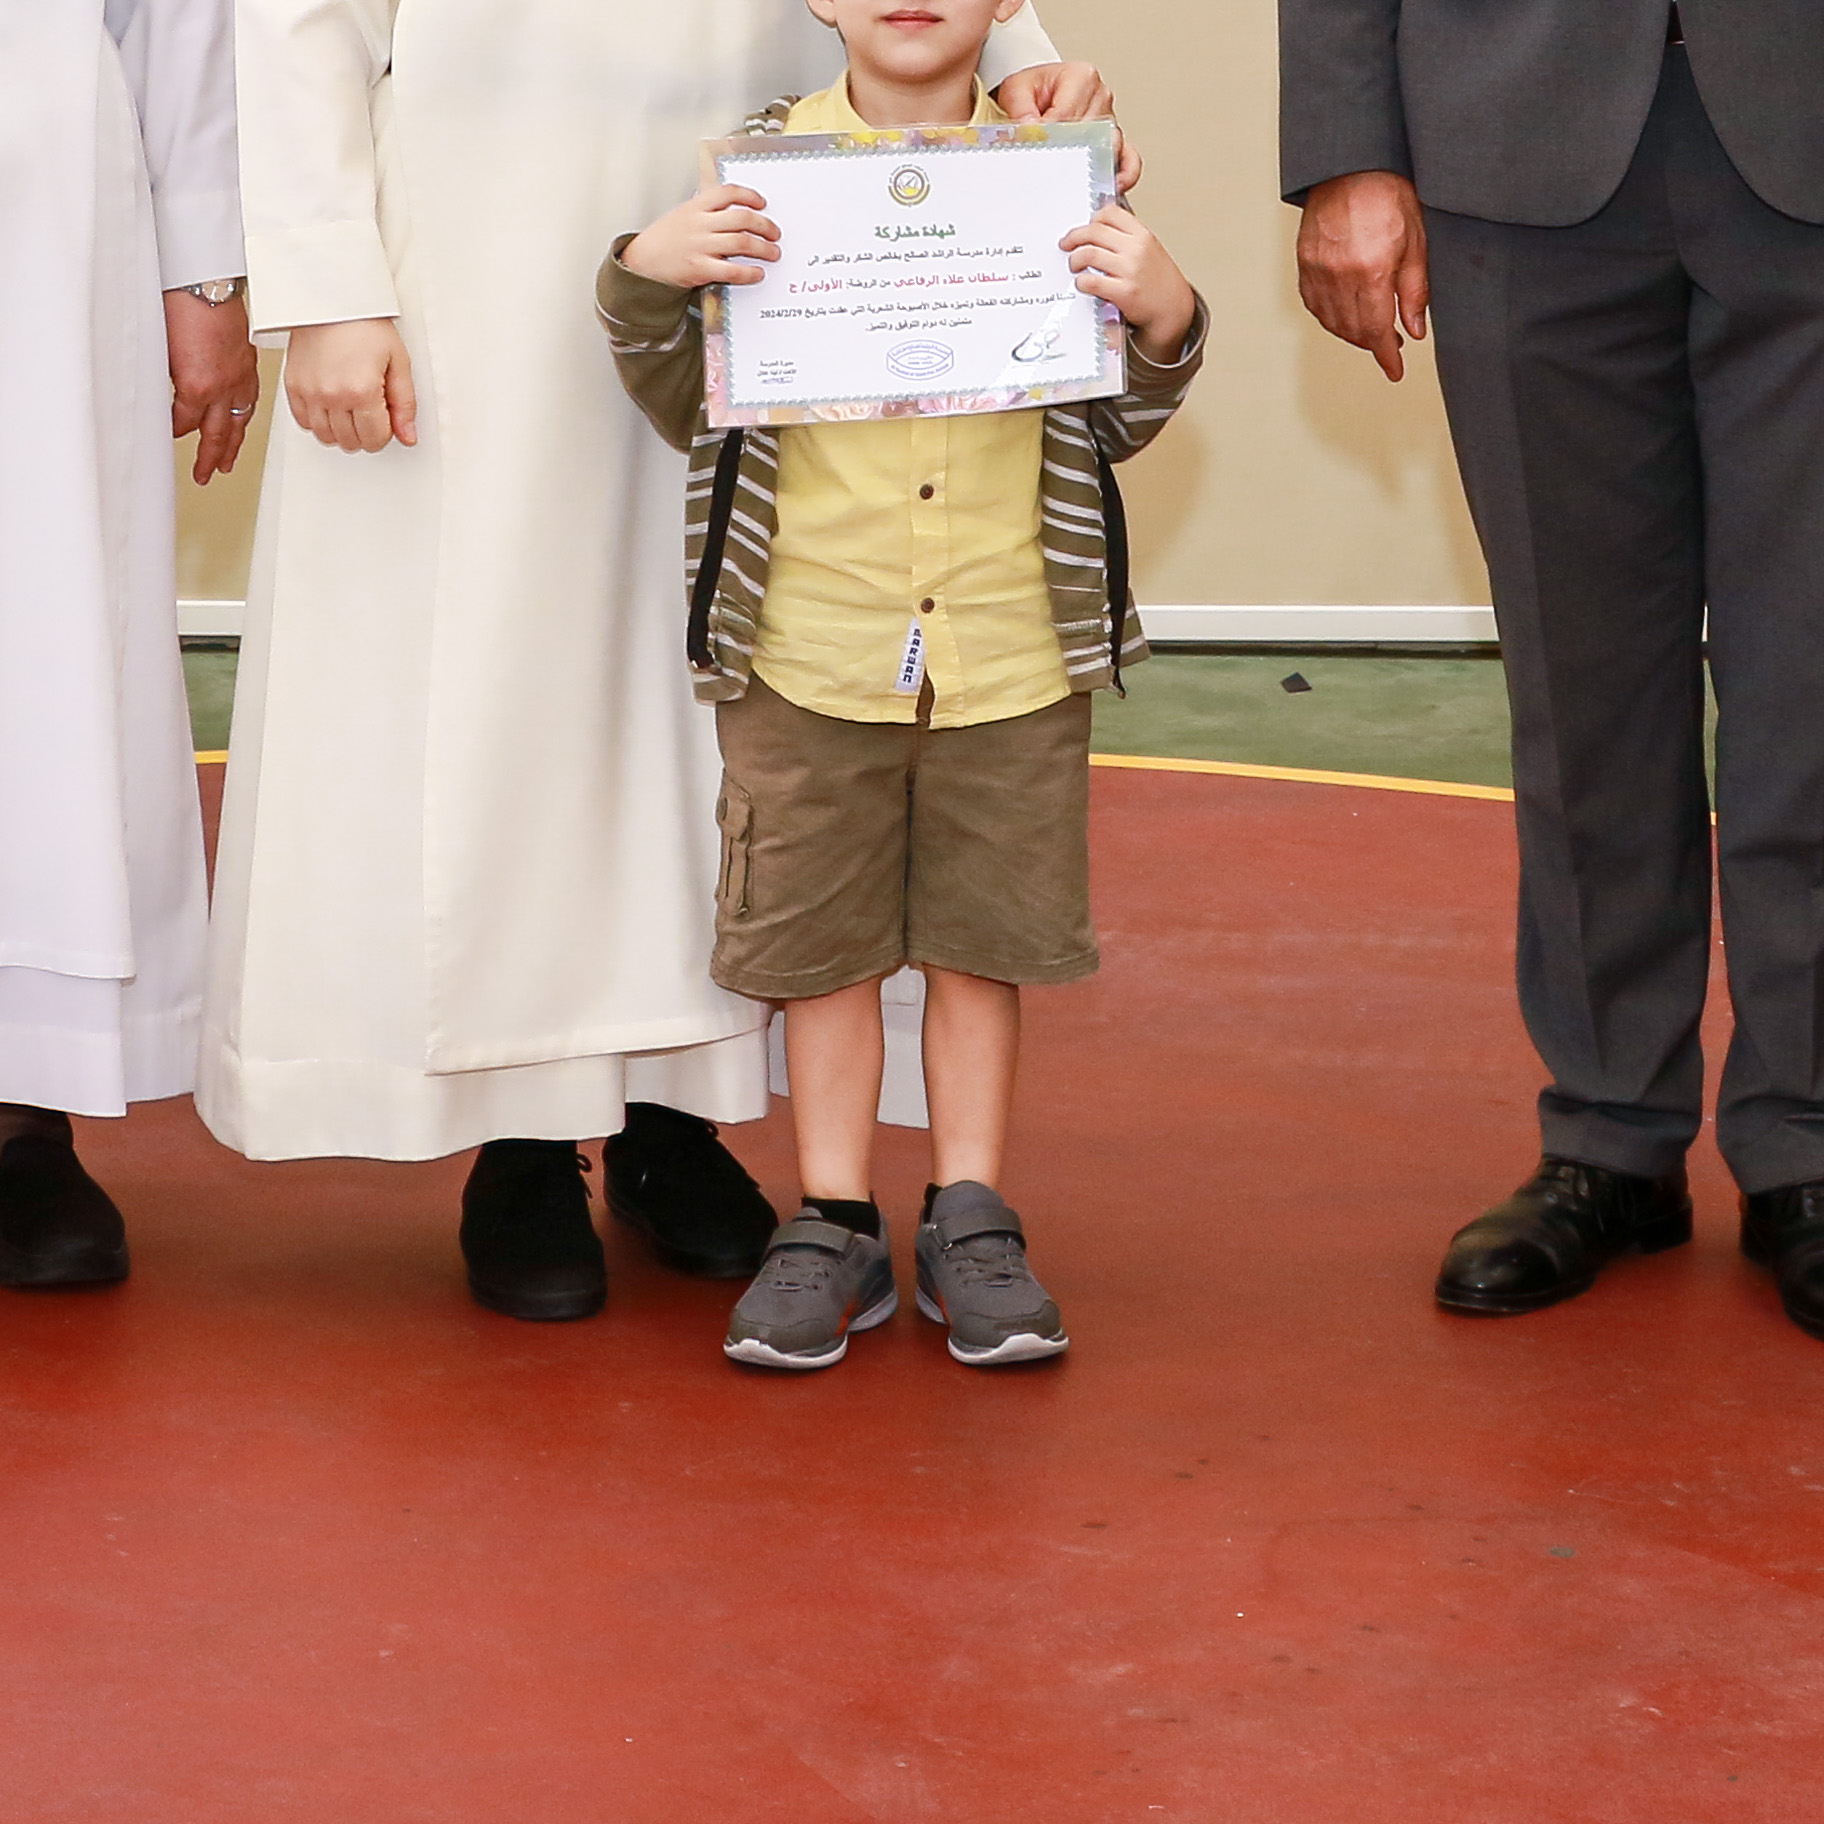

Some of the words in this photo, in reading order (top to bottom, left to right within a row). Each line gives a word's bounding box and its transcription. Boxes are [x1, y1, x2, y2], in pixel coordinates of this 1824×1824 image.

[875, 225, 920, 242] مشاركة
[923, 224, 956, 239] شهادة
[853, 253, 873, 263] الشكر
[957, 247, 983, 258] مدرسة
[943, 274, 965, 285] علاء
[968, 272, 1009, 283] سلطان
[879, 280, 891, 288] من
